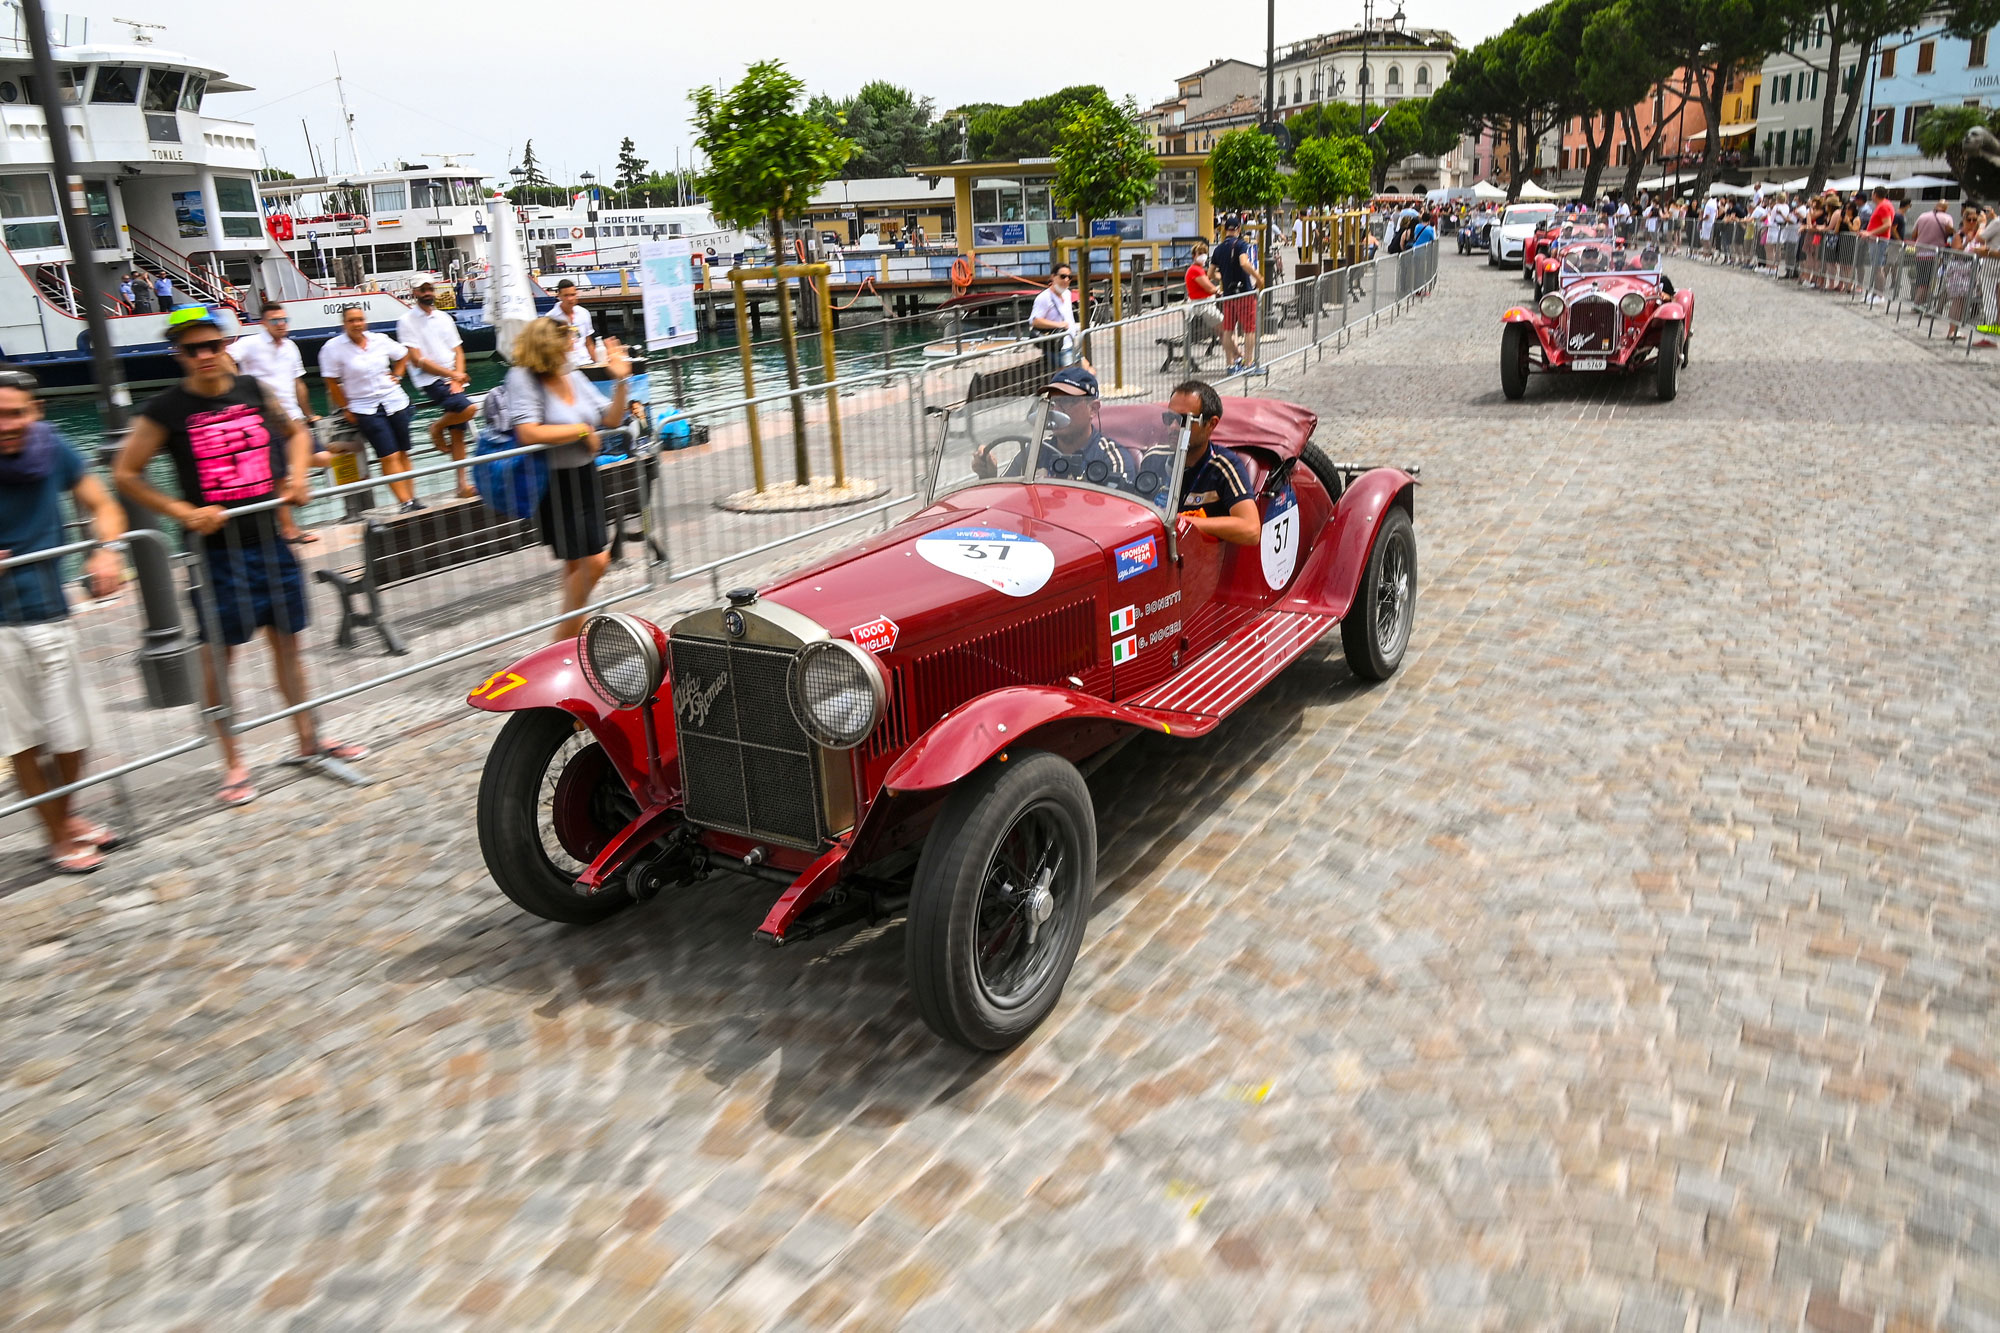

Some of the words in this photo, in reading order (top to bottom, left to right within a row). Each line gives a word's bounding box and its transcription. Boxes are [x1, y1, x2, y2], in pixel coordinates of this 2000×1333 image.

[152, 149, 183, 160] TONALE
[604, 215, 645, 224] GOETHE
[310, 231, 317, 241] 2
[690, 236, 730, 249] TRENTO
[364, 301, 371, 311] N
[1274, 516, 1289, 554] 37
[958, 543, 1011, 561] 37
[1121, 543, 1150, 561] SPONSOR
[1134, 551, 1151, 564] TEAM
[1145, 590, 1181, 616] BONETTI
[858, 623, 886, 640] 1000
[1138, 636, 1149, 649] G.
[1150, 619, 1182, 645] MOCERI
[470, 670, 529, 701] 37
[674, 671, 700, 723] Alfa
[691, 671, 728, 727] Romeo
